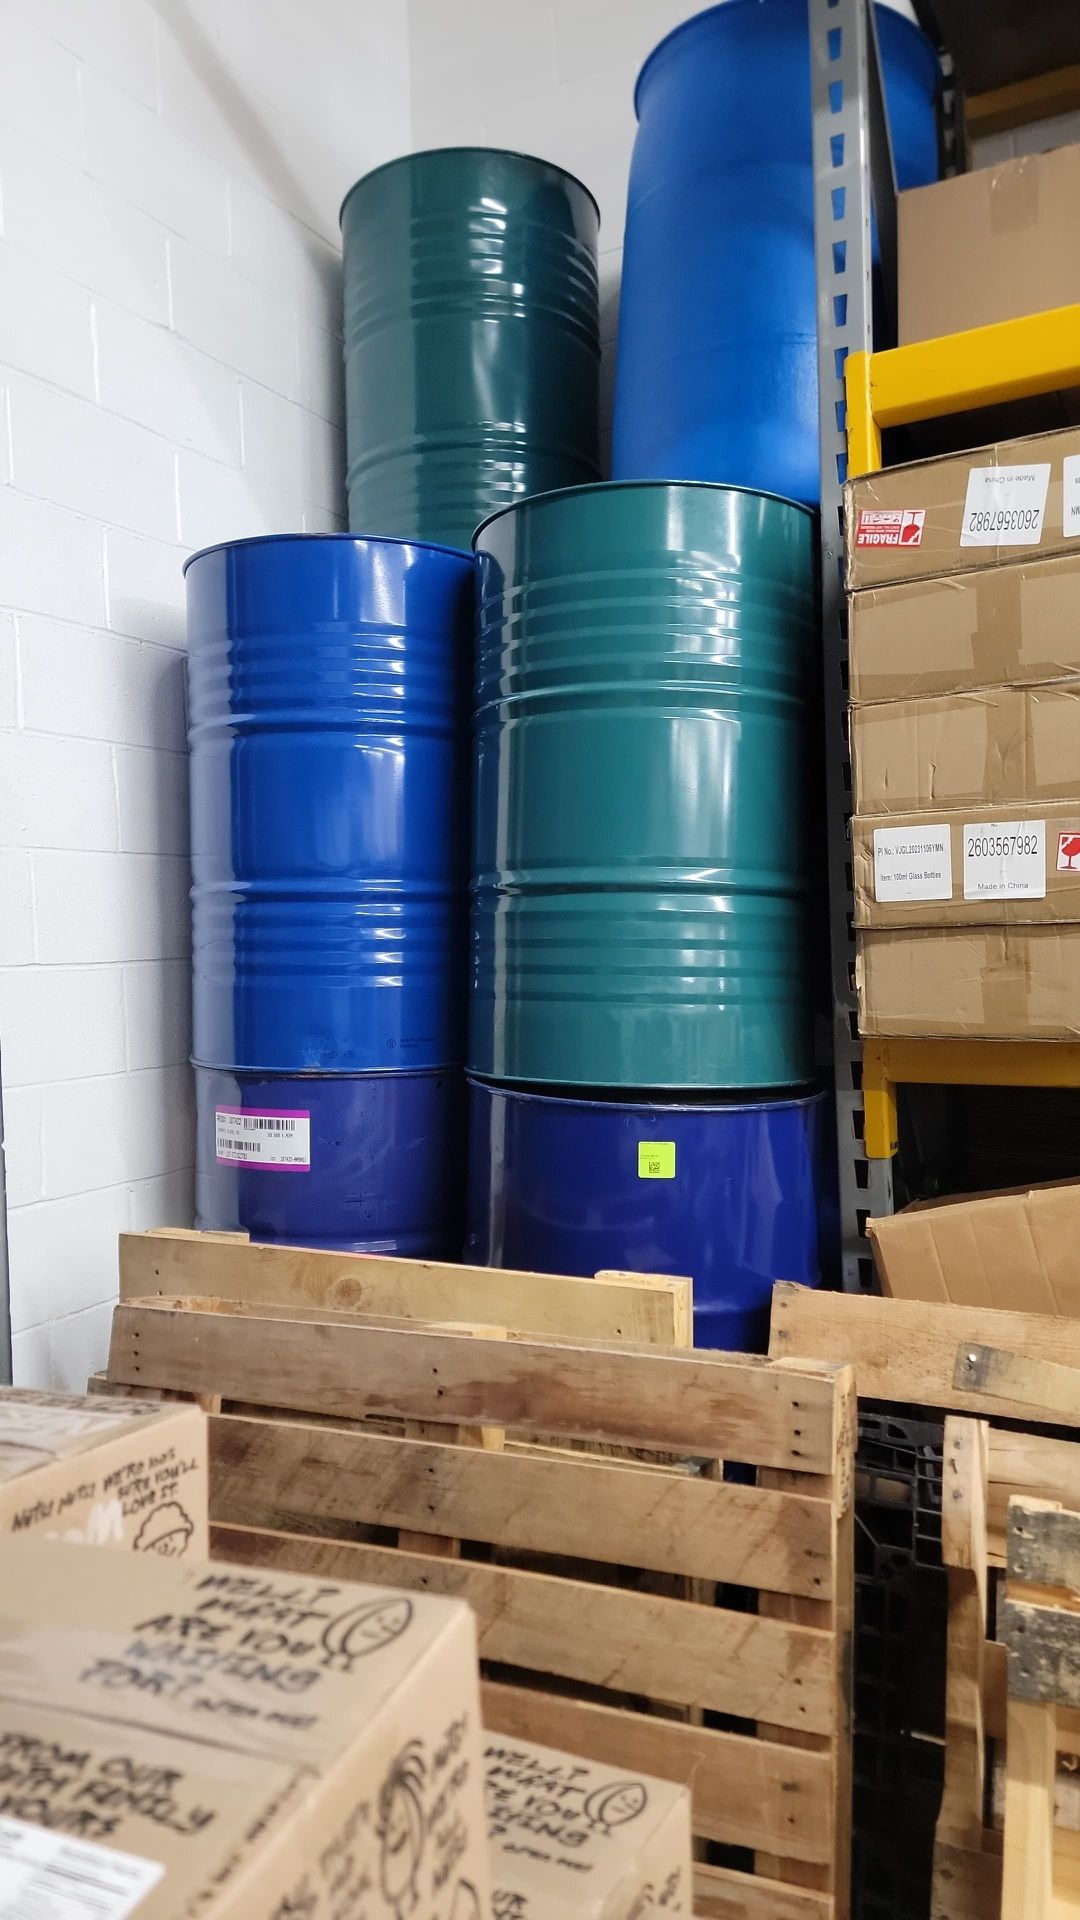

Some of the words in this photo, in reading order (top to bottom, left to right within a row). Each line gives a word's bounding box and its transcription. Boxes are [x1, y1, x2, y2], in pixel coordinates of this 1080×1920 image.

[984, 476, 1006, 485] China
[1015, 474, 1036, 483] Made
[969, 509, 1040, 533] 2603567982
[857, 533, 899, 545] FRAGILE
[967, 835, 1038, 857] 2603567982
[909, 871, 923, 880] Glass
[924, 870, 942, 880] Bottles
[977, 882, 998, 890] Made
[999, 882, 1006, 890] in
[1007, 881, 1029, 889] China
[132, 1614, 232, 1640] ARE
